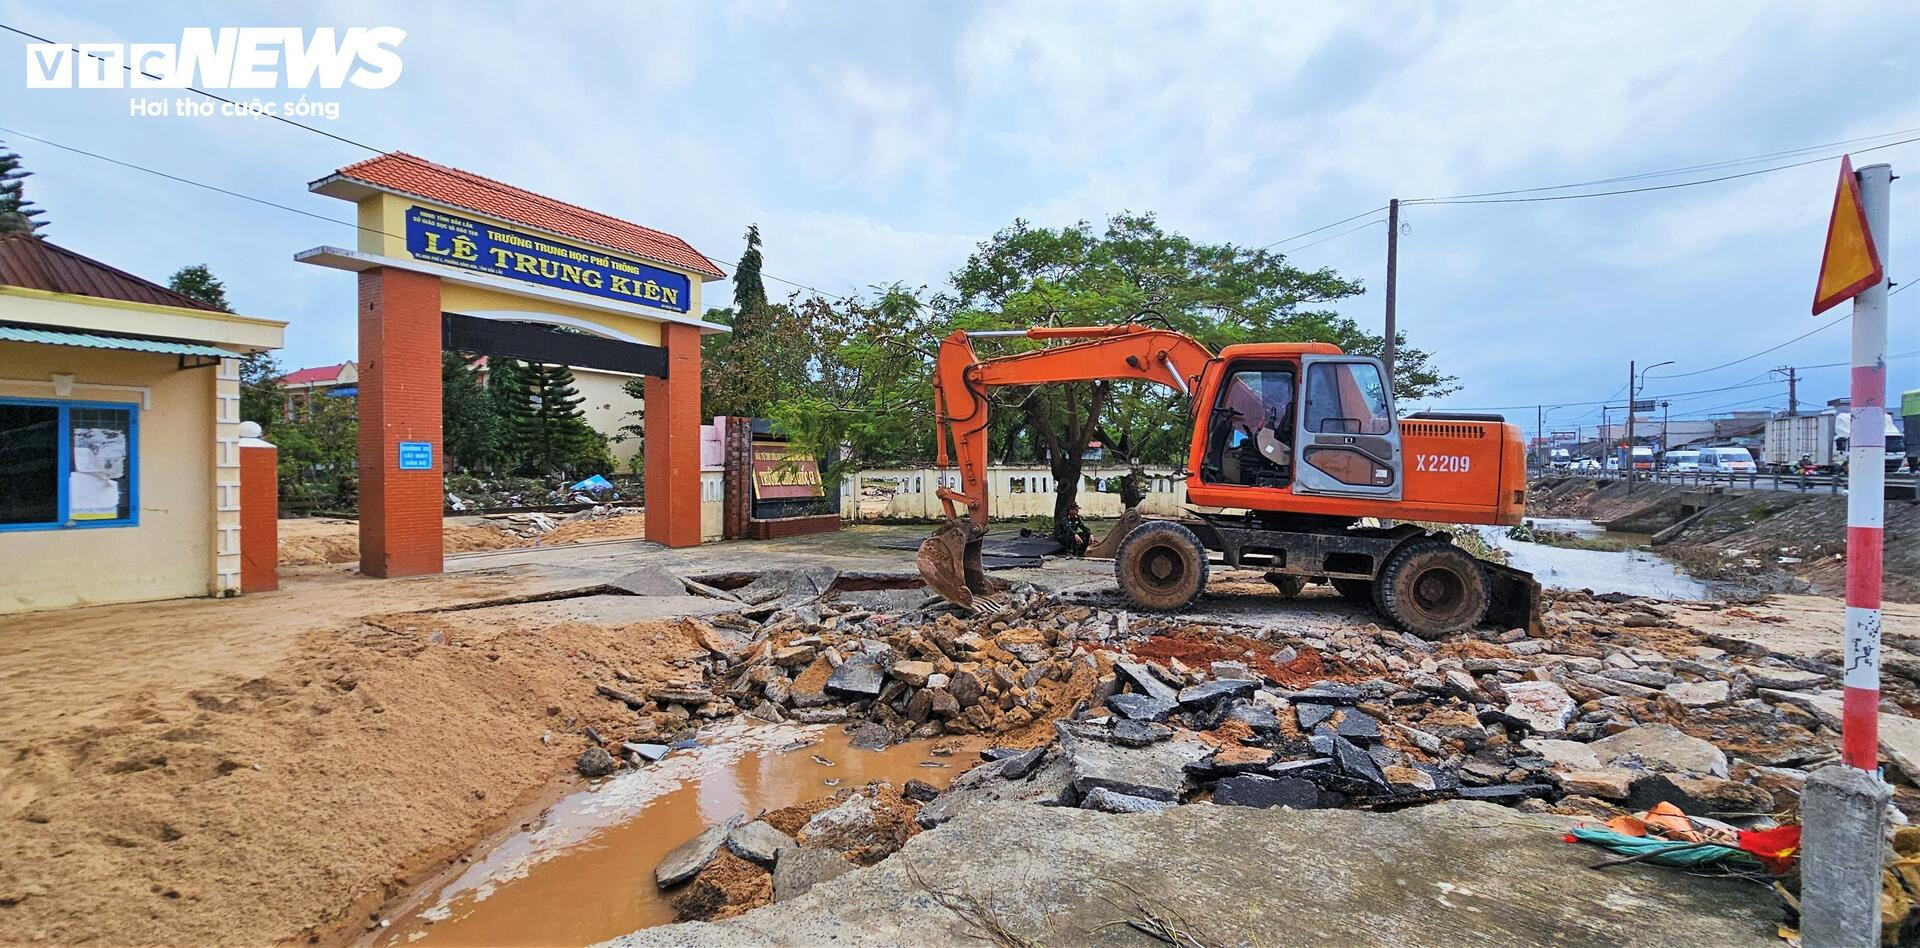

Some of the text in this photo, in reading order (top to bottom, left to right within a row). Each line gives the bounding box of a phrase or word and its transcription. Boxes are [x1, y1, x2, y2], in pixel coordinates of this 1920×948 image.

[424, 231, 679, 305] LÊ TRUNG KIÊN
[487, 230, 640, 275] TRƯỜNG TRUNG HỌC PHỐ THÔNG
[1416, 454, 1470, 473] X 2209
